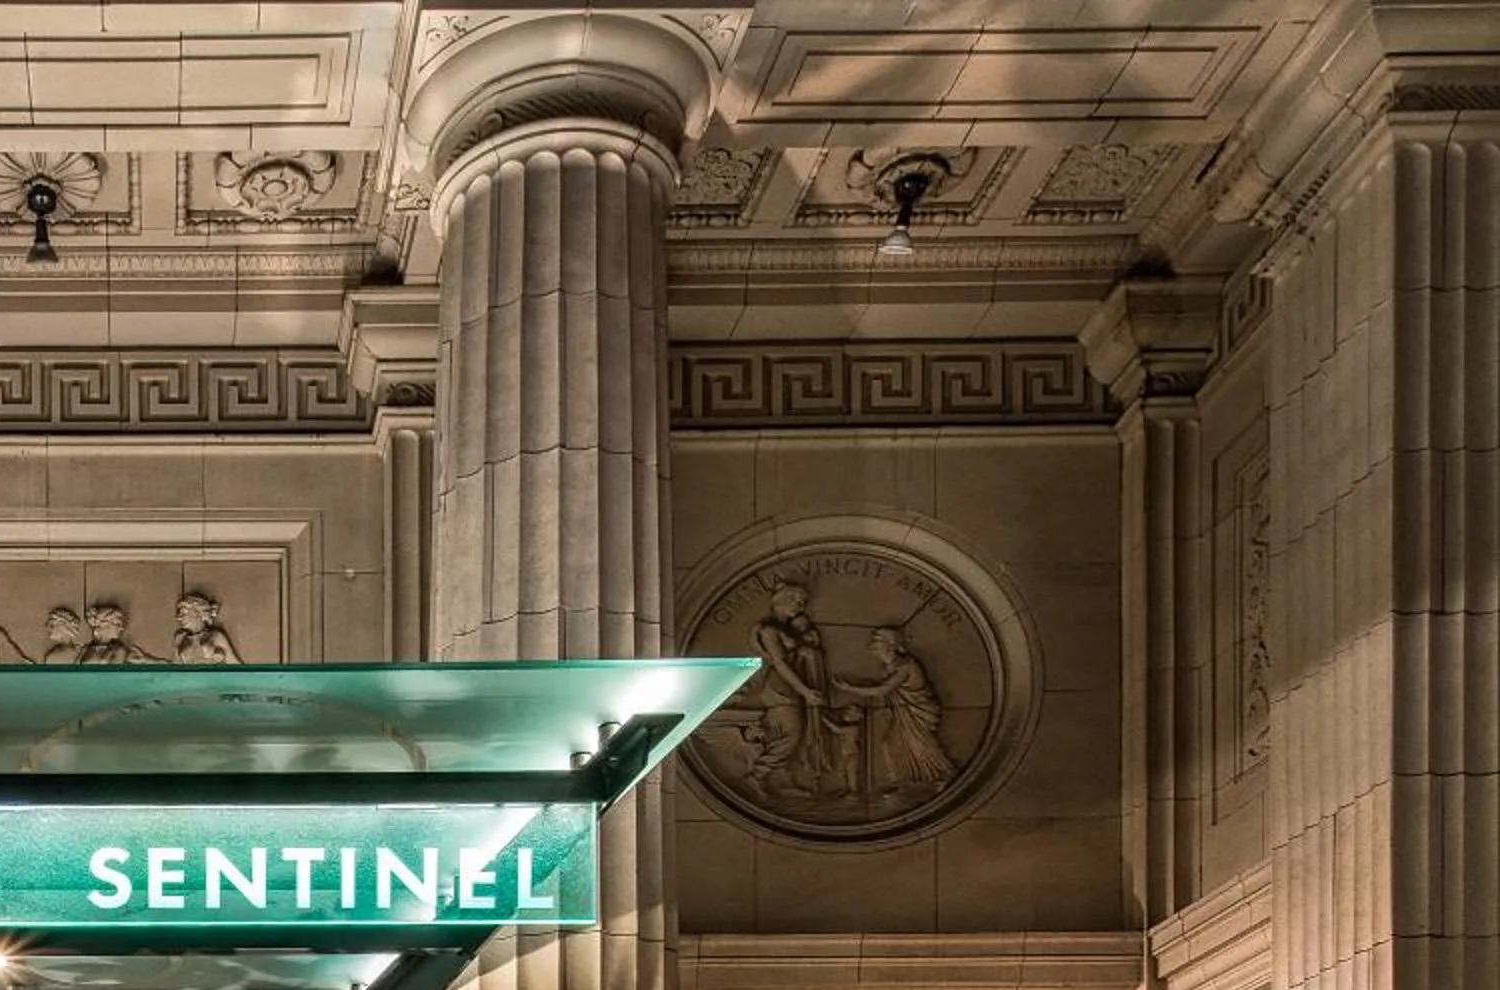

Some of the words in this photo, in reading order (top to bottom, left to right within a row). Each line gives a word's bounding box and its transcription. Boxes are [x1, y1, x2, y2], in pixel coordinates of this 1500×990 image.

[799, 558, 888, 580] VINCIT
[893, 575, 963, 629] AMOR
[87, 845, 555, 910] SENTINEL
